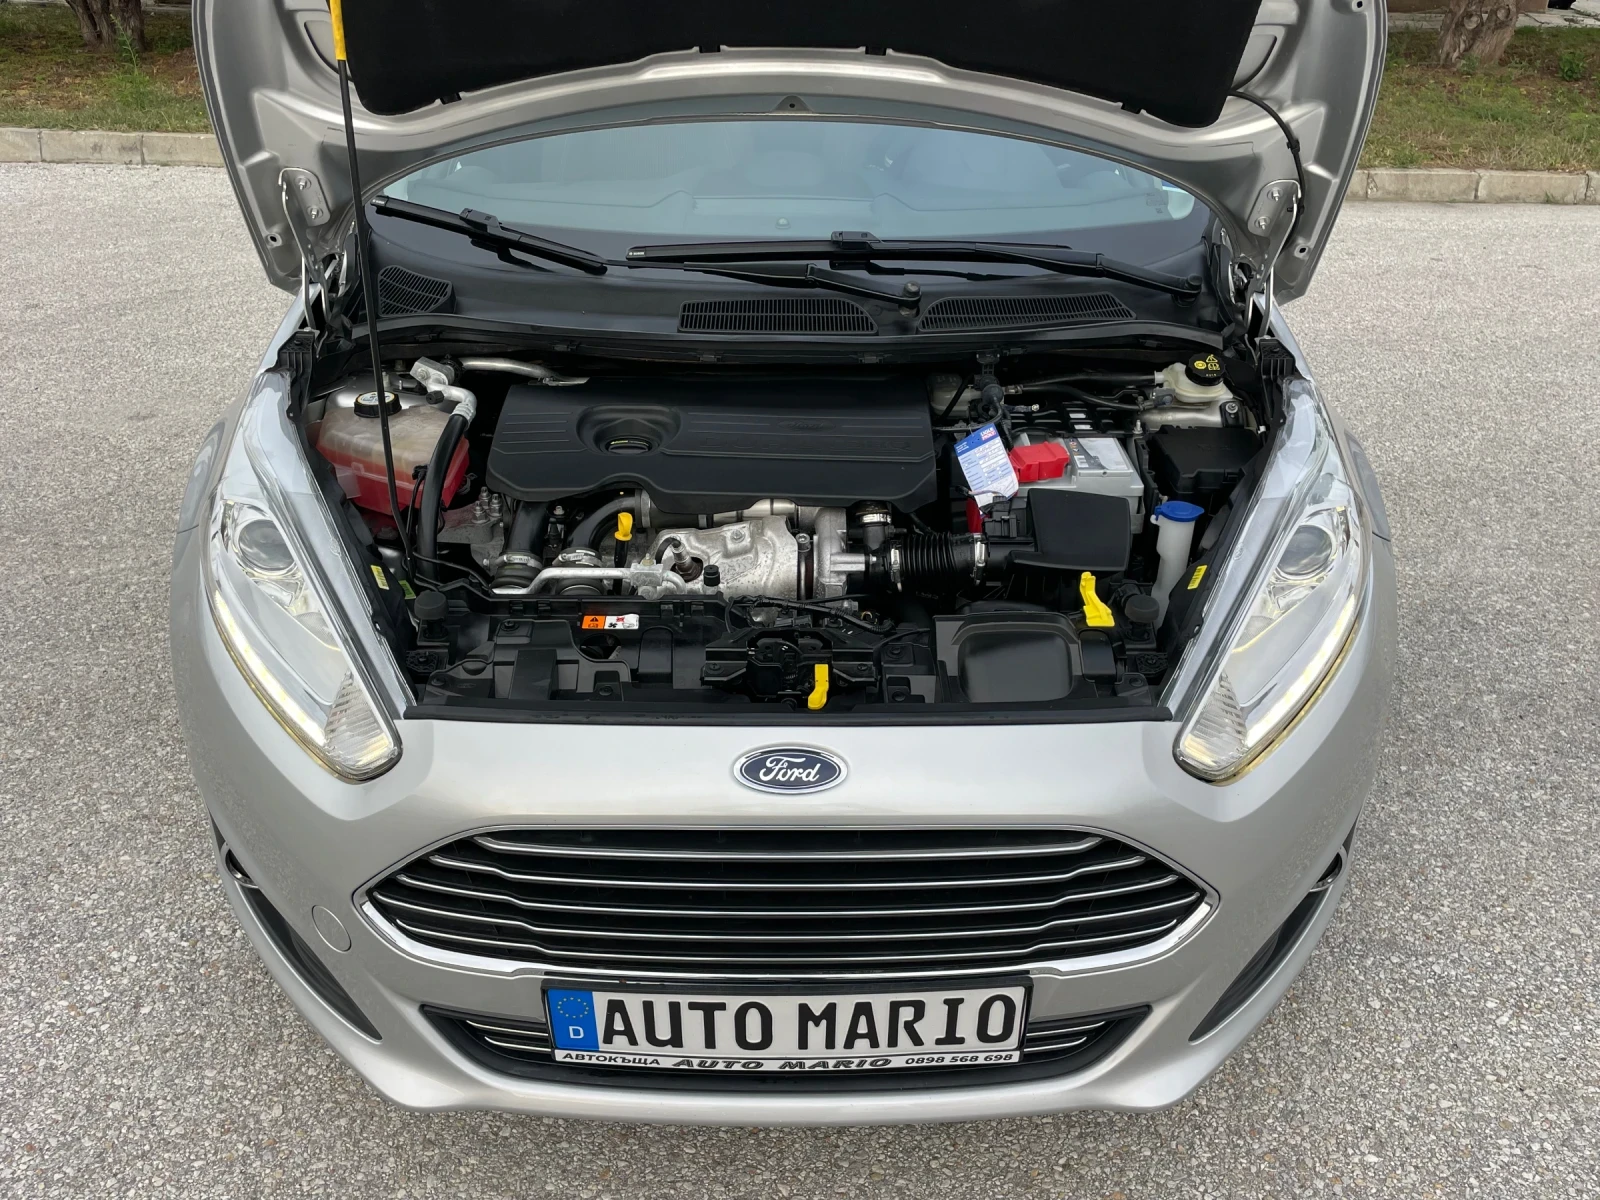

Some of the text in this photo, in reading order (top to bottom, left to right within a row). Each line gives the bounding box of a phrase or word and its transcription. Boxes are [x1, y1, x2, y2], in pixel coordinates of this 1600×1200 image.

[759, 756, 821, 781] Ford
[569, 1026, 584, 1039] D
[602, 994, 1016, 1051] AUTO MARIO
[562, 1053, 1014, 1070] АВТОКЪЩА AUTO MARIO 0898 568 698
